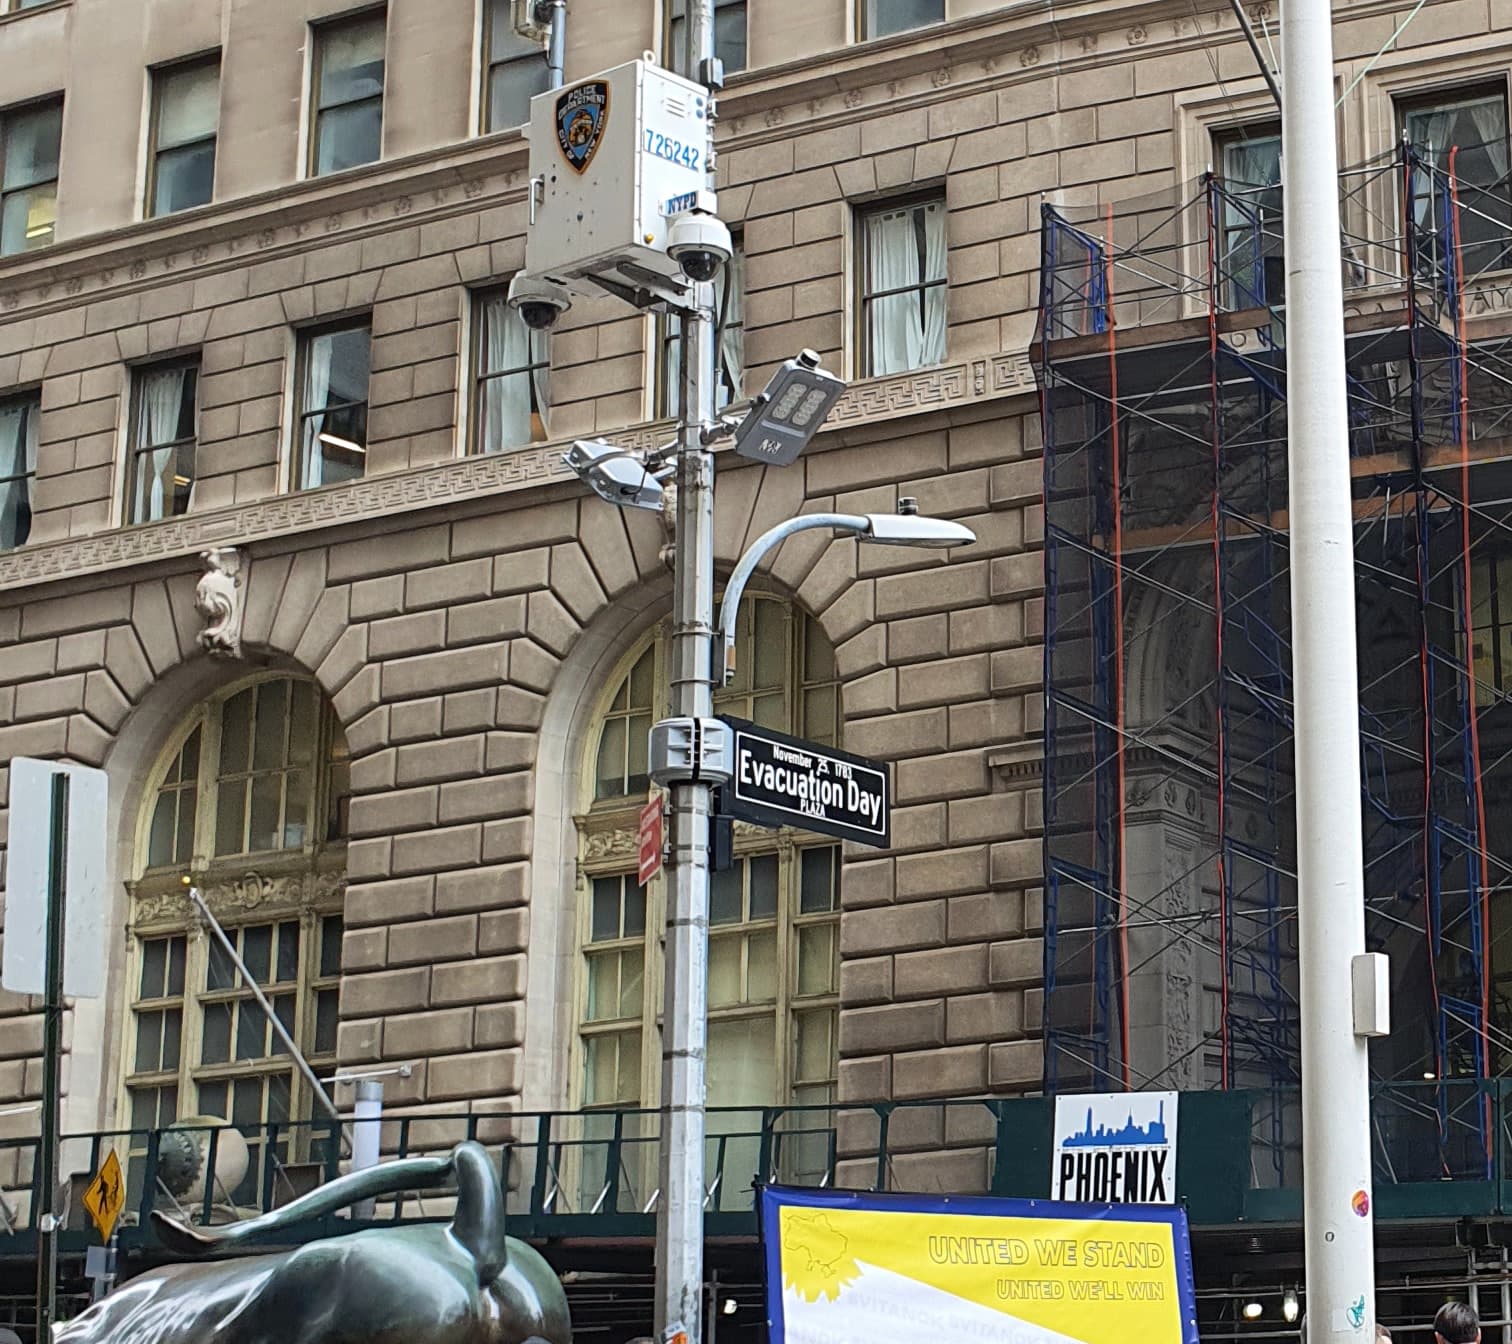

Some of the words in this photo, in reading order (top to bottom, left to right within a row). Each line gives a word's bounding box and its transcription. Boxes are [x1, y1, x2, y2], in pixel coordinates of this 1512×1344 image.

[645, 128, 700, 172] 726242
[667, 191, 697, 215] NYPD
[773, 744, 813, 769] November
[740, 749, 843, 809] Evacuation
[847, 780, 881, 826] Day
[800, 799, 826, 818] PLAZA
[1059, 1149, 1168, 1203] PHOENIX
[928, 1235, 1030, 1265] UNITED
[1034, 1238, 1078, 1267] WE
[1083, 1240, 1166, 1269] STAND
[996, 1278, 1065, 1300] UNITED
[1068, 1279, 1124, 1301] WE'LL
[1127, 1280, 1165, 1301] WIN
